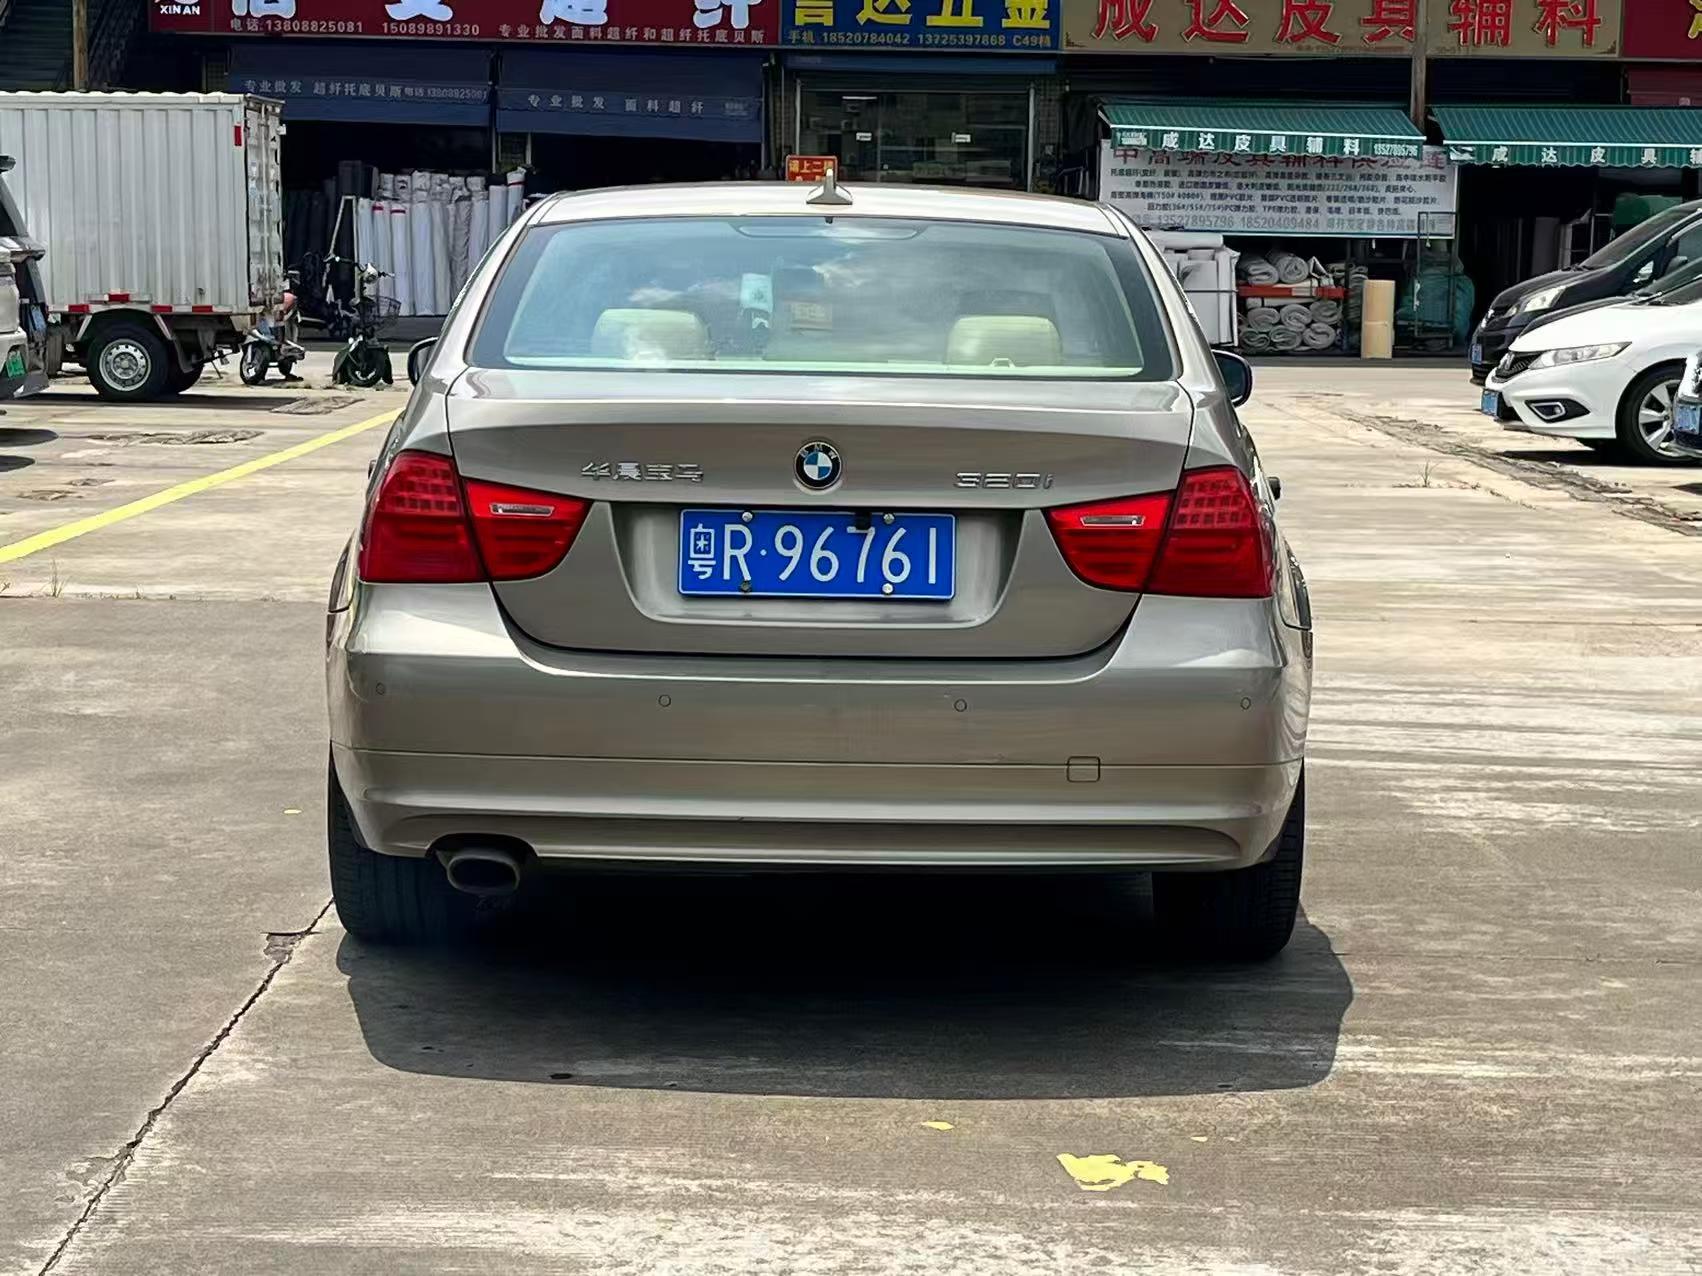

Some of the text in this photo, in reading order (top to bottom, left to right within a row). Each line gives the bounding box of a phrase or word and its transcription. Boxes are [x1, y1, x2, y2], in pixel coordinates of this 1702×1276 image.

[382, 22, 480, 36] 15089891330
[787, 29, 815, 43] 手机
[822, 32, 910, 45] 18520784042
[800, 443, 838, 460] BMW
[581, 462, 704, 482] 华晨宝马
